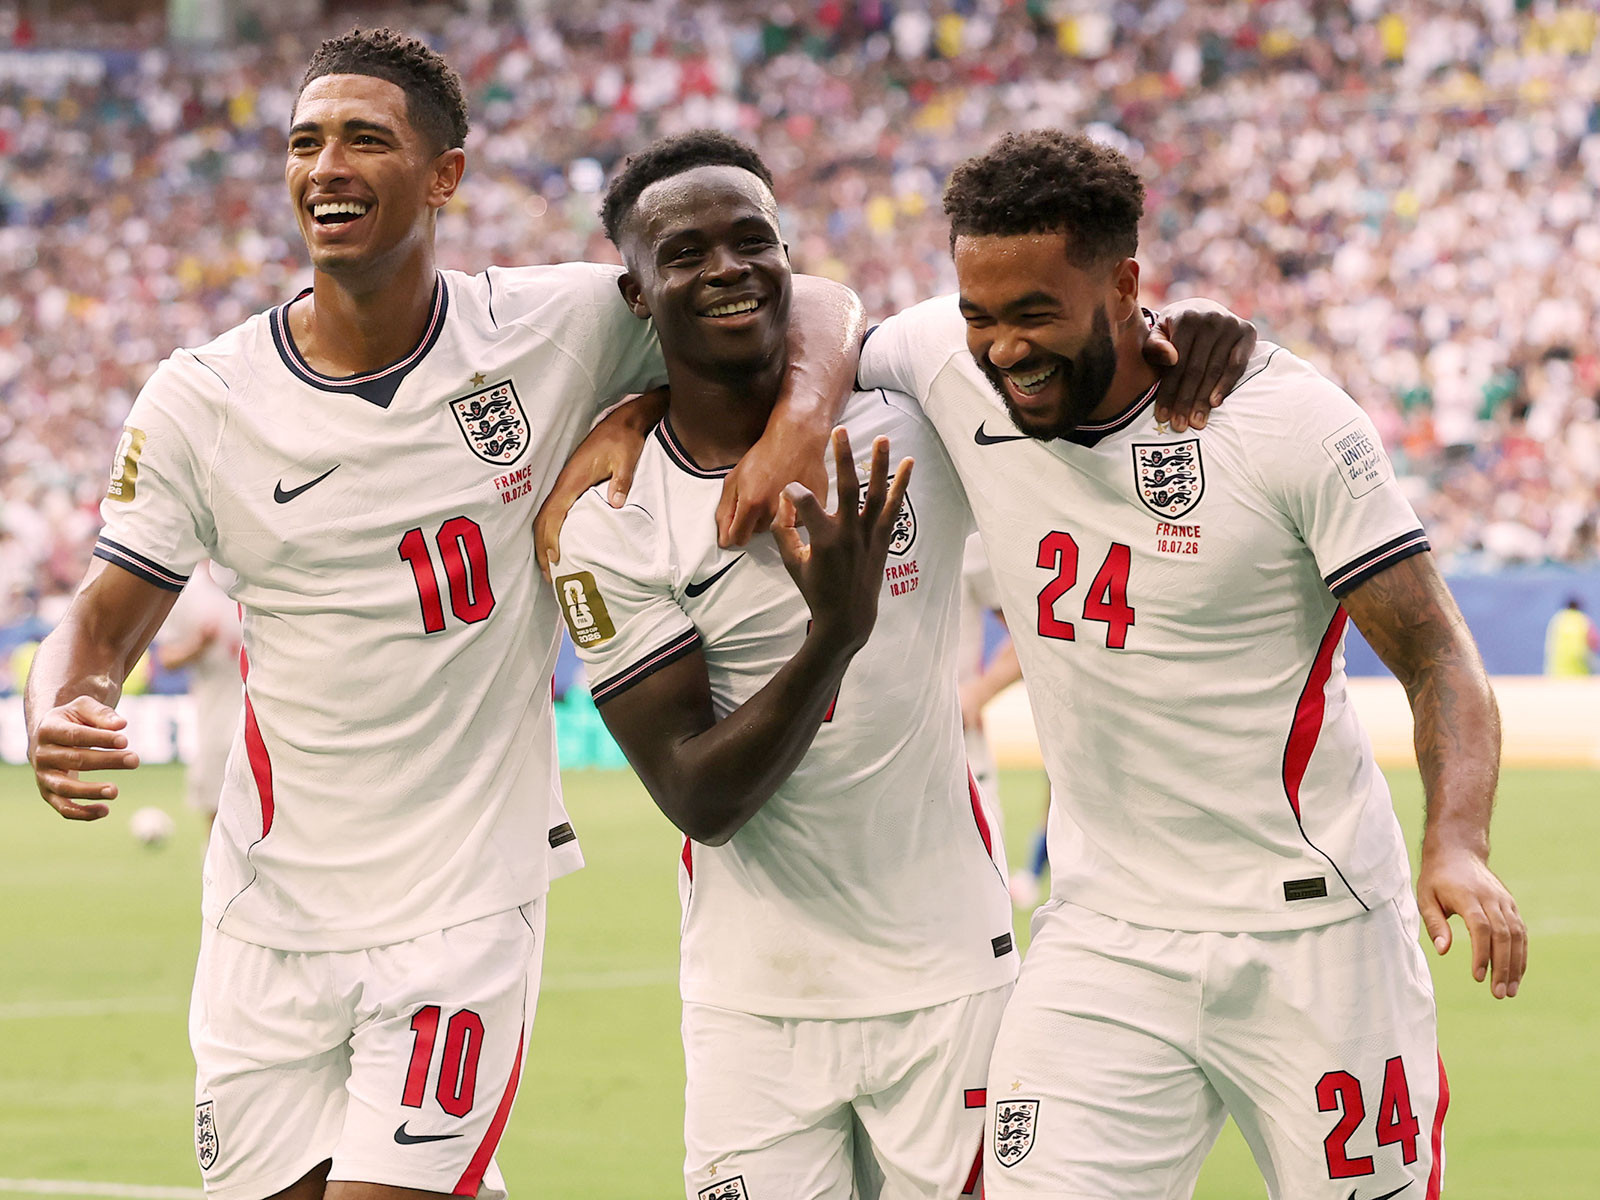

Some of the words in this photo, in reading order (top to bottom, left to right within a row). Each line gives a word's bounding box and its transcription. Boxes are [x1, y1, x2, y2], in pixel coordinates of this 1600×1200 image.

[1341, 437, 1375, 466] UNITES
[494, 464, 532, 490] FRANCE
[1348, 465, 1364, 480] the
[1365, 470, 1379, 481] FIFA
[501, 479, 532, 505] 18.07.26
[1156, 522, 1201, 538] FRANCE
[1157, 539, 1199, 554] 18.07.26
[397, 515, 496, 634] 10
[885, 560, 919, 581] FRANCE
[1036, 530, 1135, 649] 24
[578, 632, 602, 643] 2026
[401, 1005, 485, 1118] 10
[1315, 1055, 1420, 1179] 24
